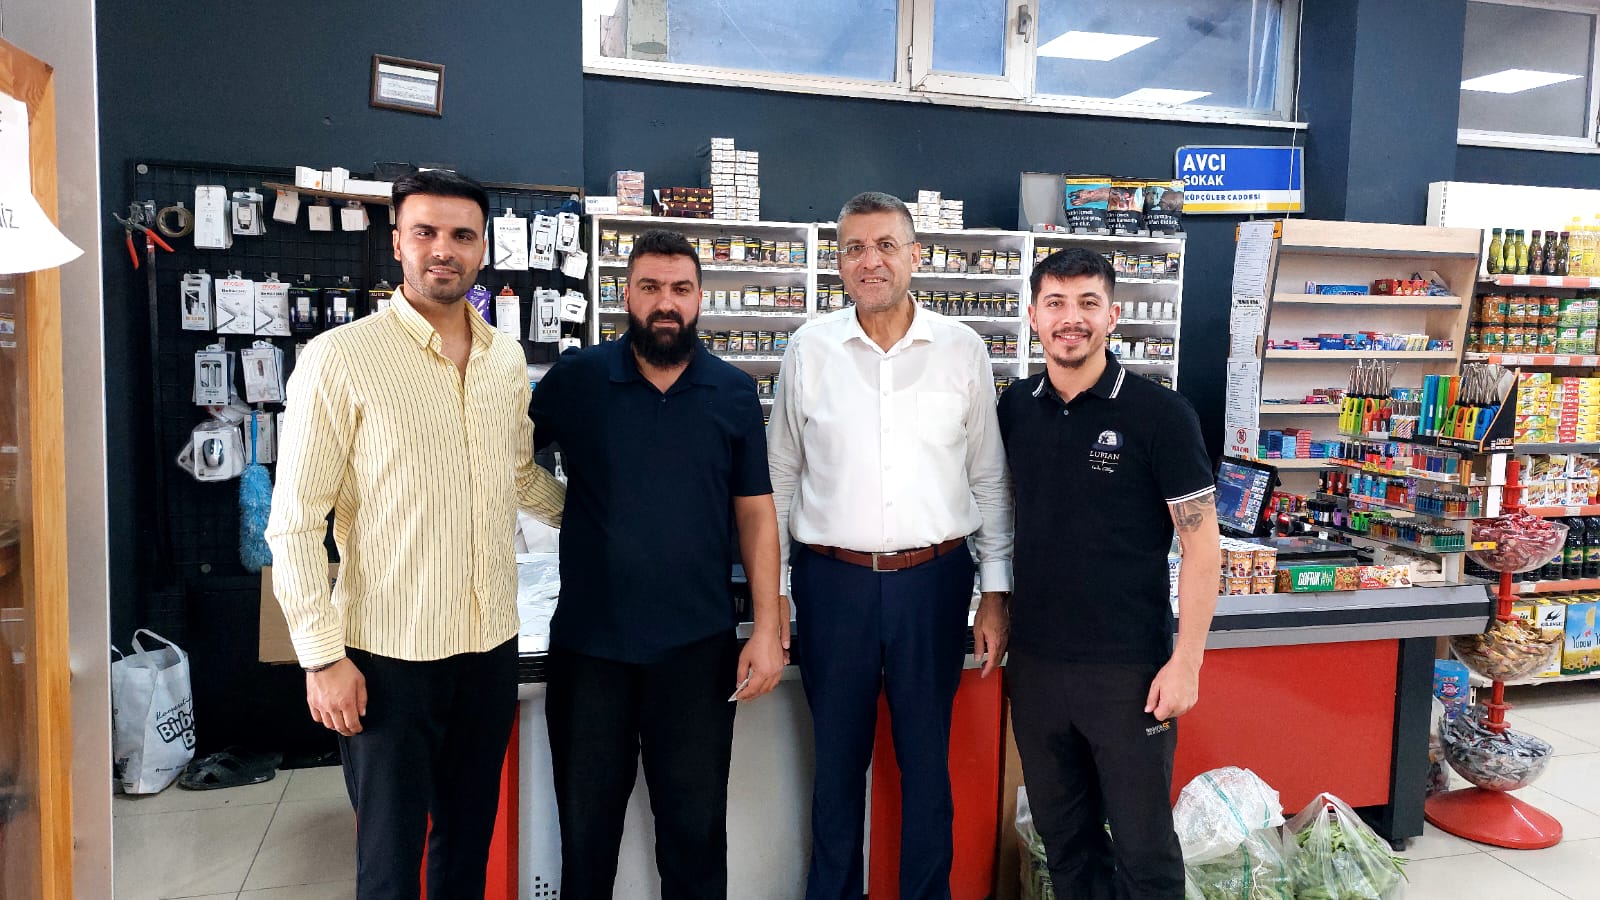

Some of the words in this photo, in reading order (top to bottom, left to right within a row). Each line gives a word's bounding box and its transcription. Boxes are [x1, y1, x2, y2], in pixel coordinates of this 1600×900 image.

[1183, 153, 1226, 172] AVCI
[1183, 174, 1225, 186] SOKAK
[1184, 192, 1226, 202] KÜPÇÜLER
[1228, 192, 1261, 201] CADDESİ
